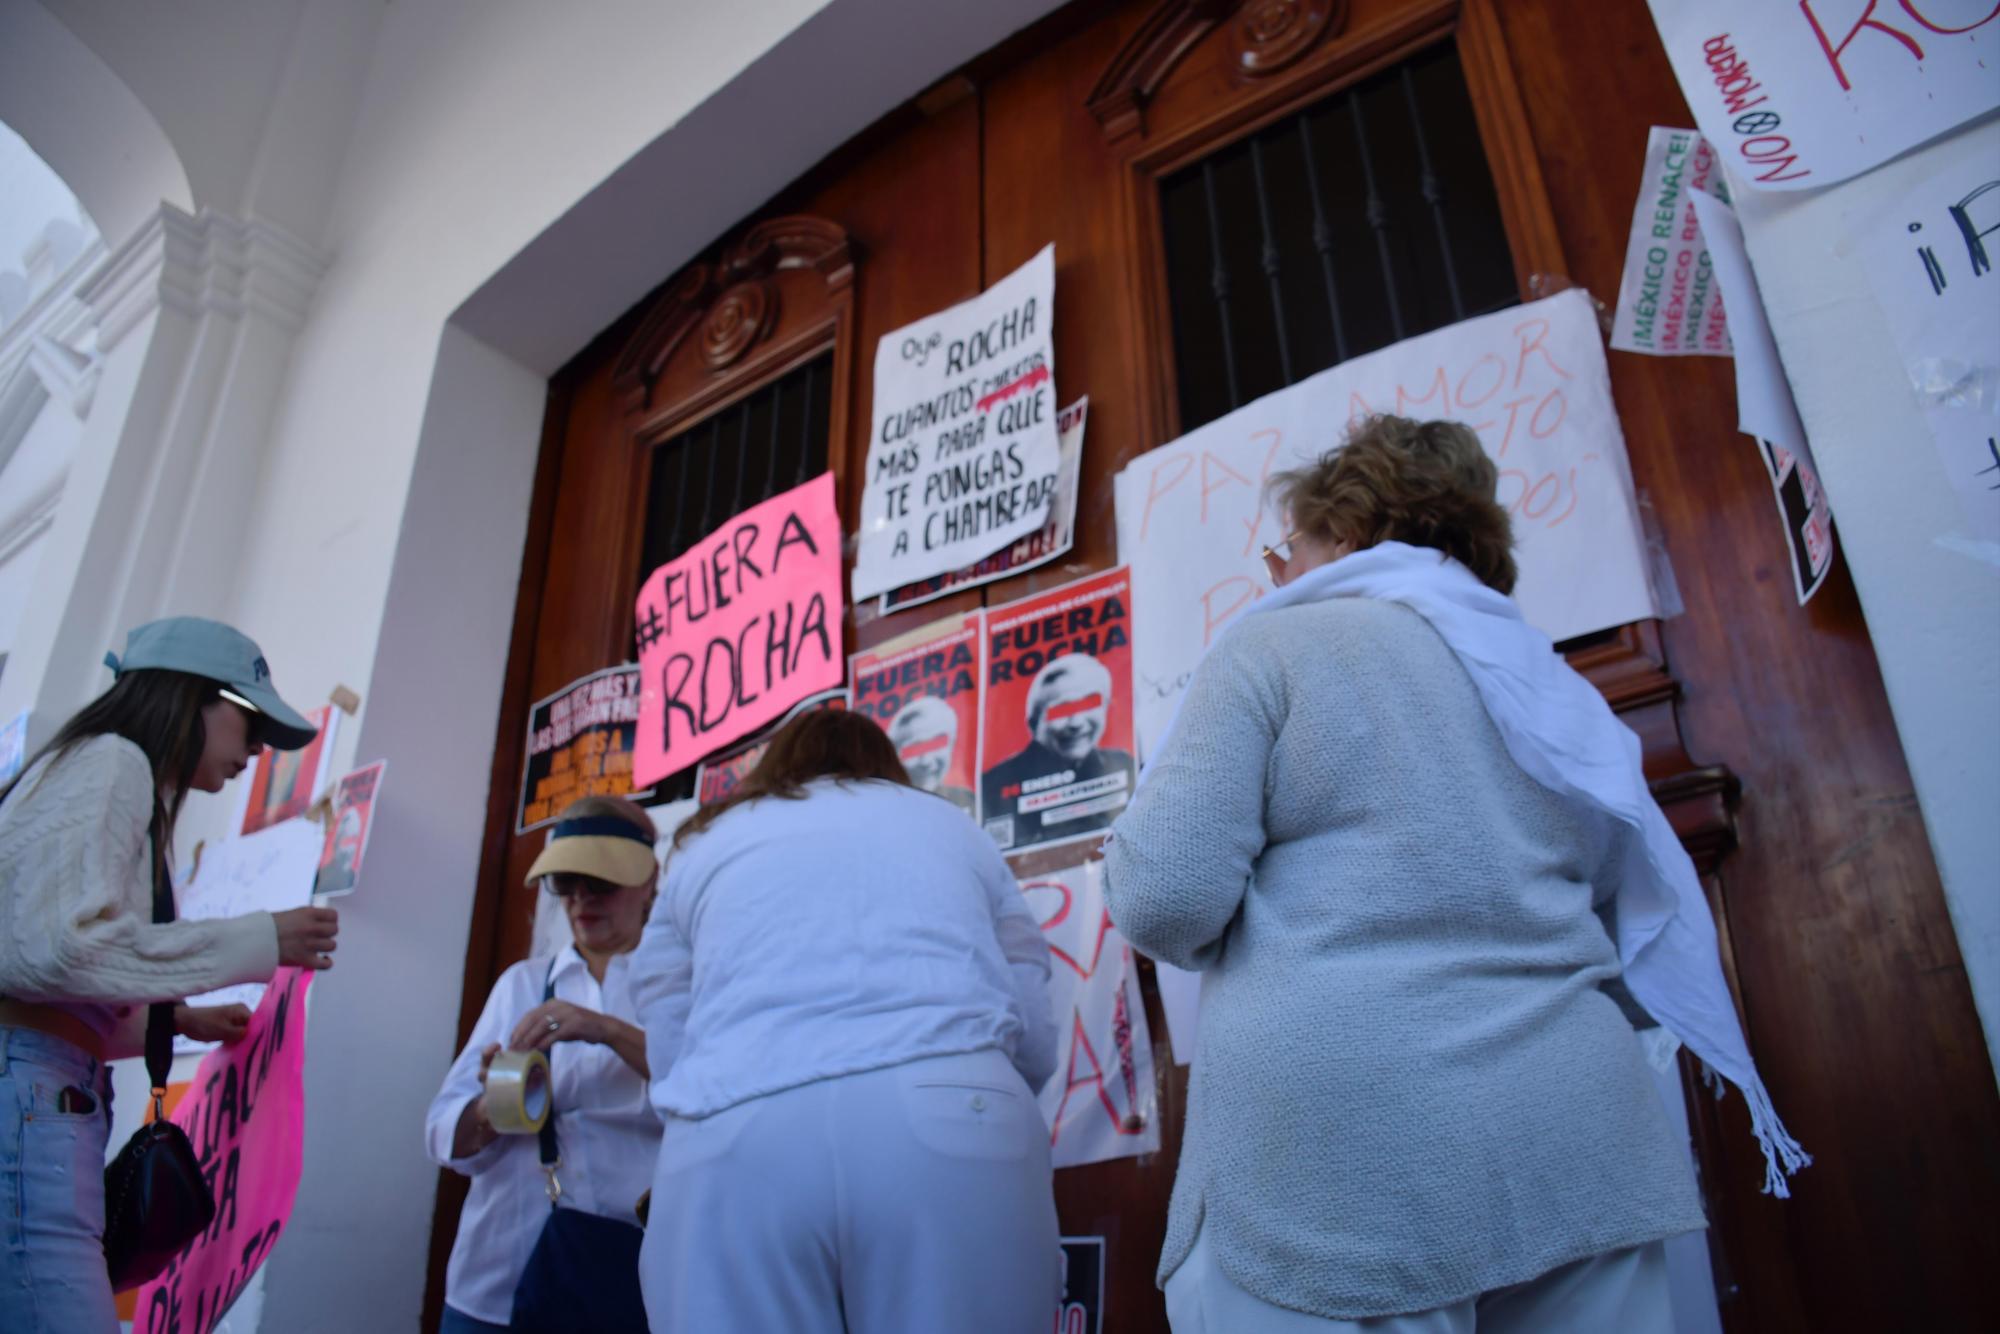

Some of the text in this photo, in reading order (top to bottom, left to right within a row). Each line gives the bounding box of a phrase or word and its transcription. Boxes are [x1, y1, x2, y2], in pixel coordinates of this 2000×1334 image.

[1740, 135, 1812, 182] NO
[1632, 133, 1690, 348] ¡MÉXICO RENACE!
[946, 297, 1036, 377] ROCHA
[881, 379, 978, 444] CUANTOS
[935, 416, 987, 463] PARA
[997, 389, 1045, 435] QUE
[886, 443, 1024, 521] TE PONGAS
[891, 530, 909, 557] A
[637, 512, 818, 651] #FUERA
[990, 625, 1128, 687] ROCHA
[992, 595, 1125, 658] FUERA
[663, 592, 831, 752] ROCHA
[857, 643, 973, 701] FUERA
